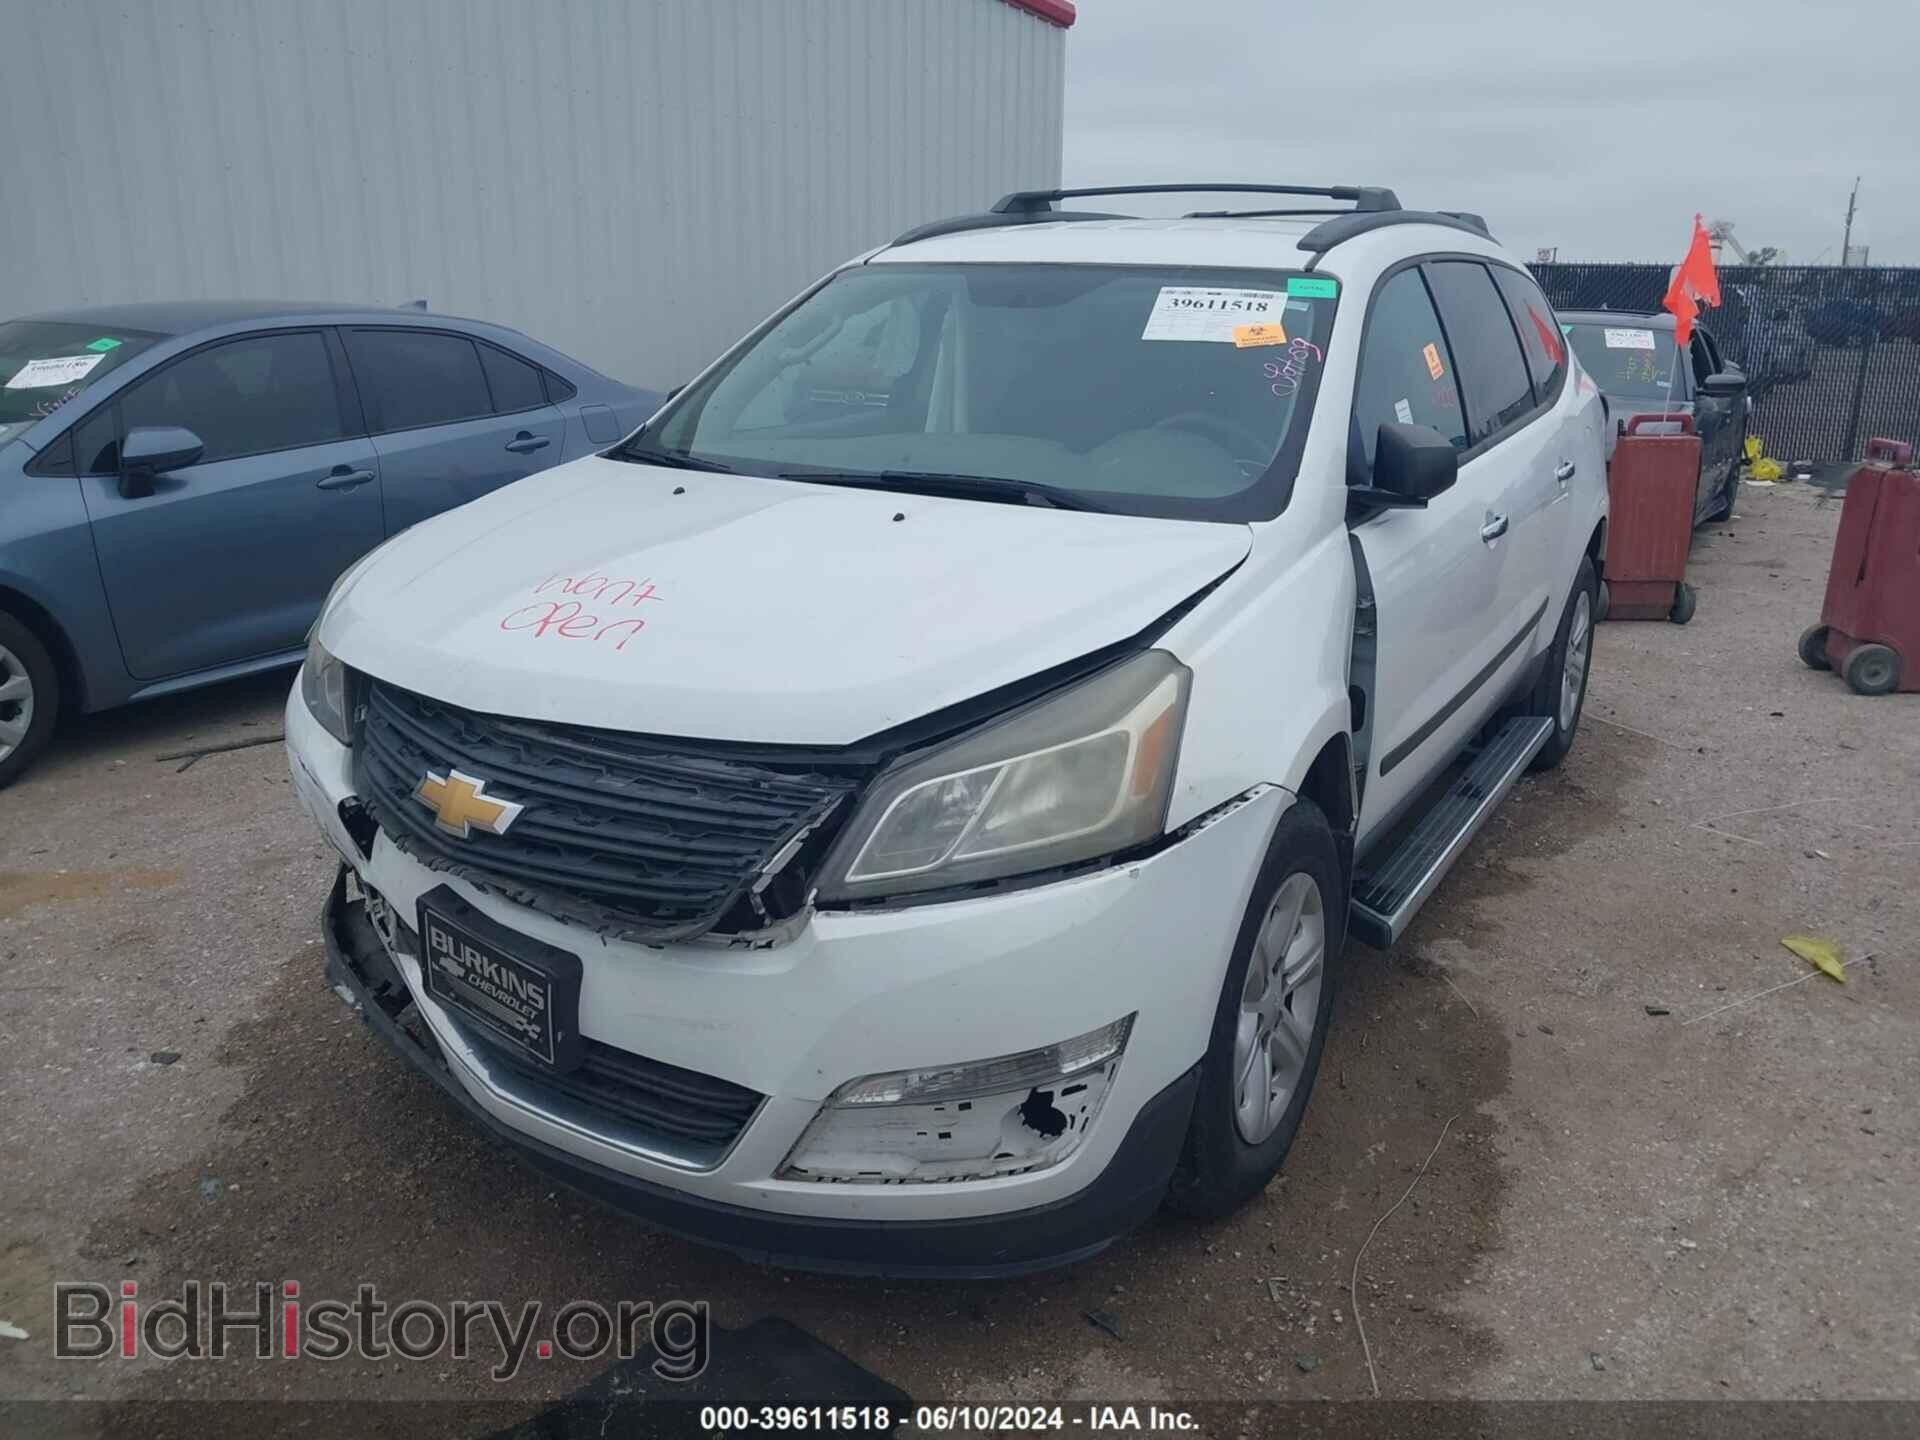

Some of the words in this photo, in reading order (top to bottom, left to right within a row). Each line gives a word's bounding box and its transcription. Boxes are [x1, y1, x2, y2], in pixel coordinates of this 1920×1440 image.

[1168, 298, 1268, 312] 39611518
[430, 925, 544, 1010] BURKINS
[468, 973, 538, 1019] CHEVROLET
